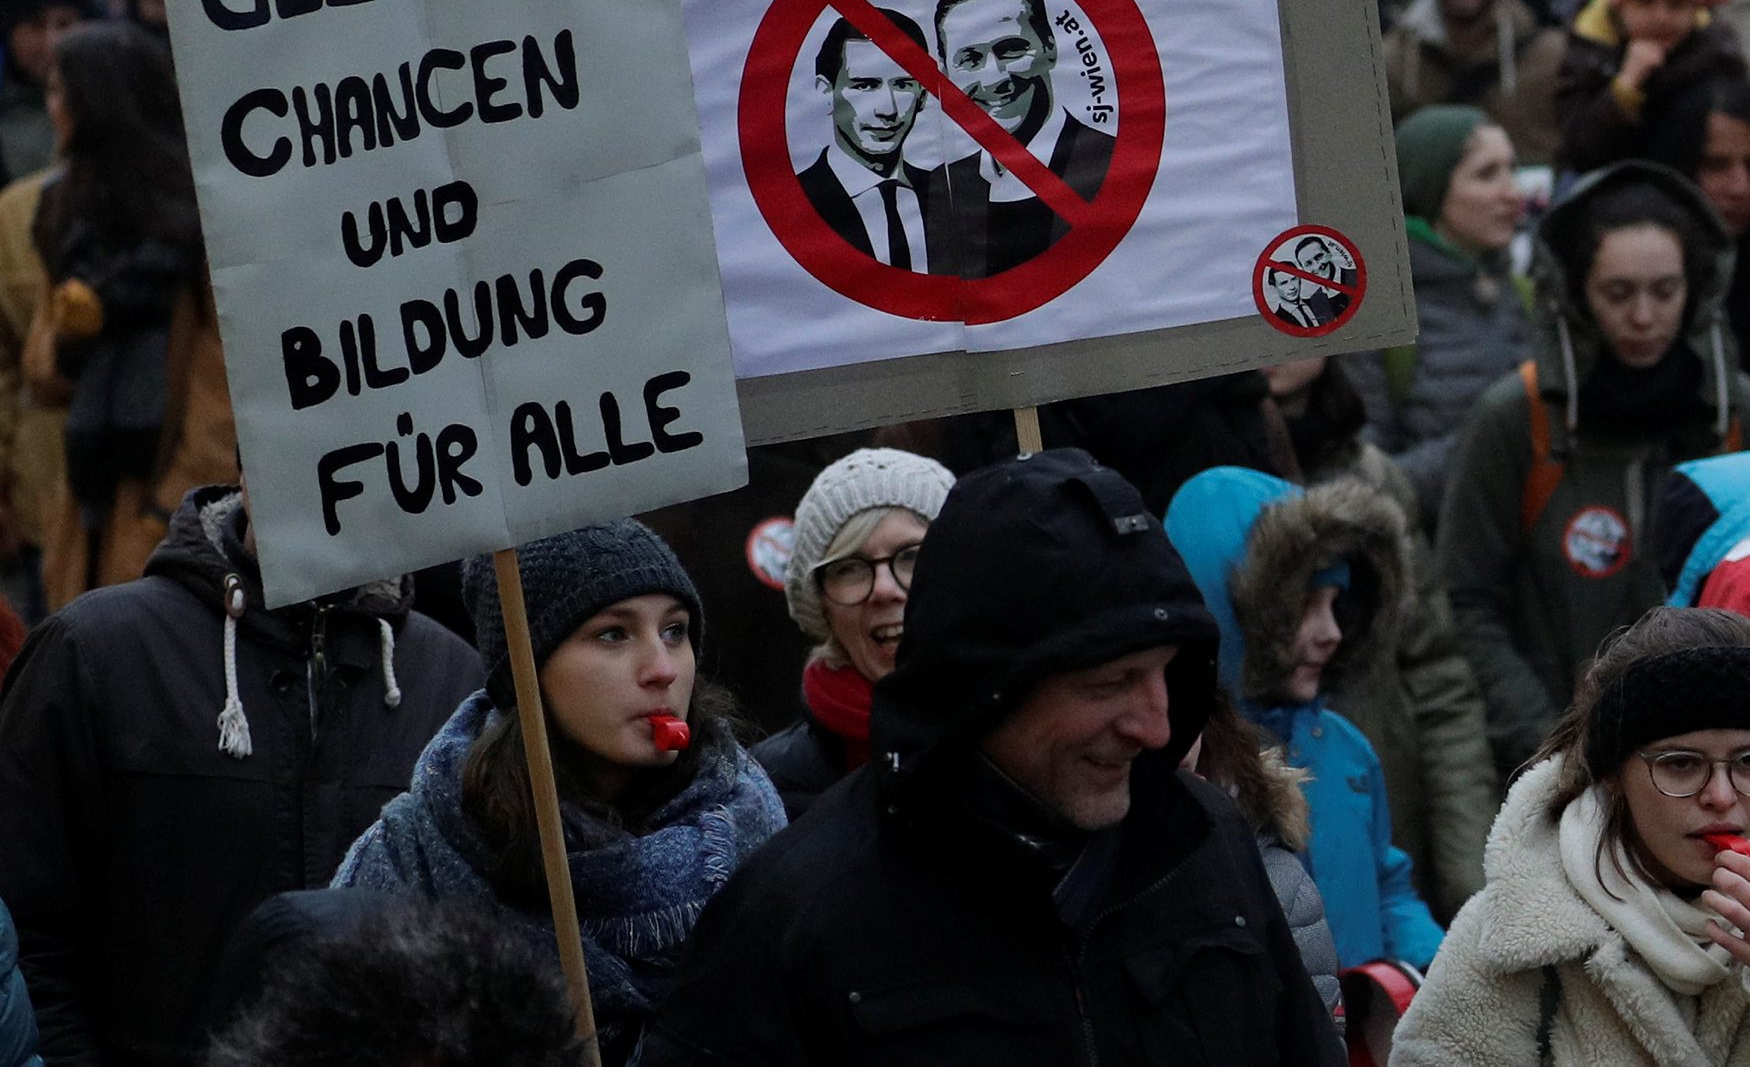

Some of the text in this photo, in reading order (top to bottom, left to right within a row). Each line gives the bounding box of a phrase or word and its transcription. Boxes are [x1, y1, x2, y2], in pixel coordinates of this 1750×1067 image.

[220, 28, 580, 178] CHANCEN
[1055, 9, 1114, 124] sj-wien.at
[341, 180, 479, 268] UND
[280, 258, 604, 410] BILDUNG
[316, 370, 704, 536] FÜR ALLE
